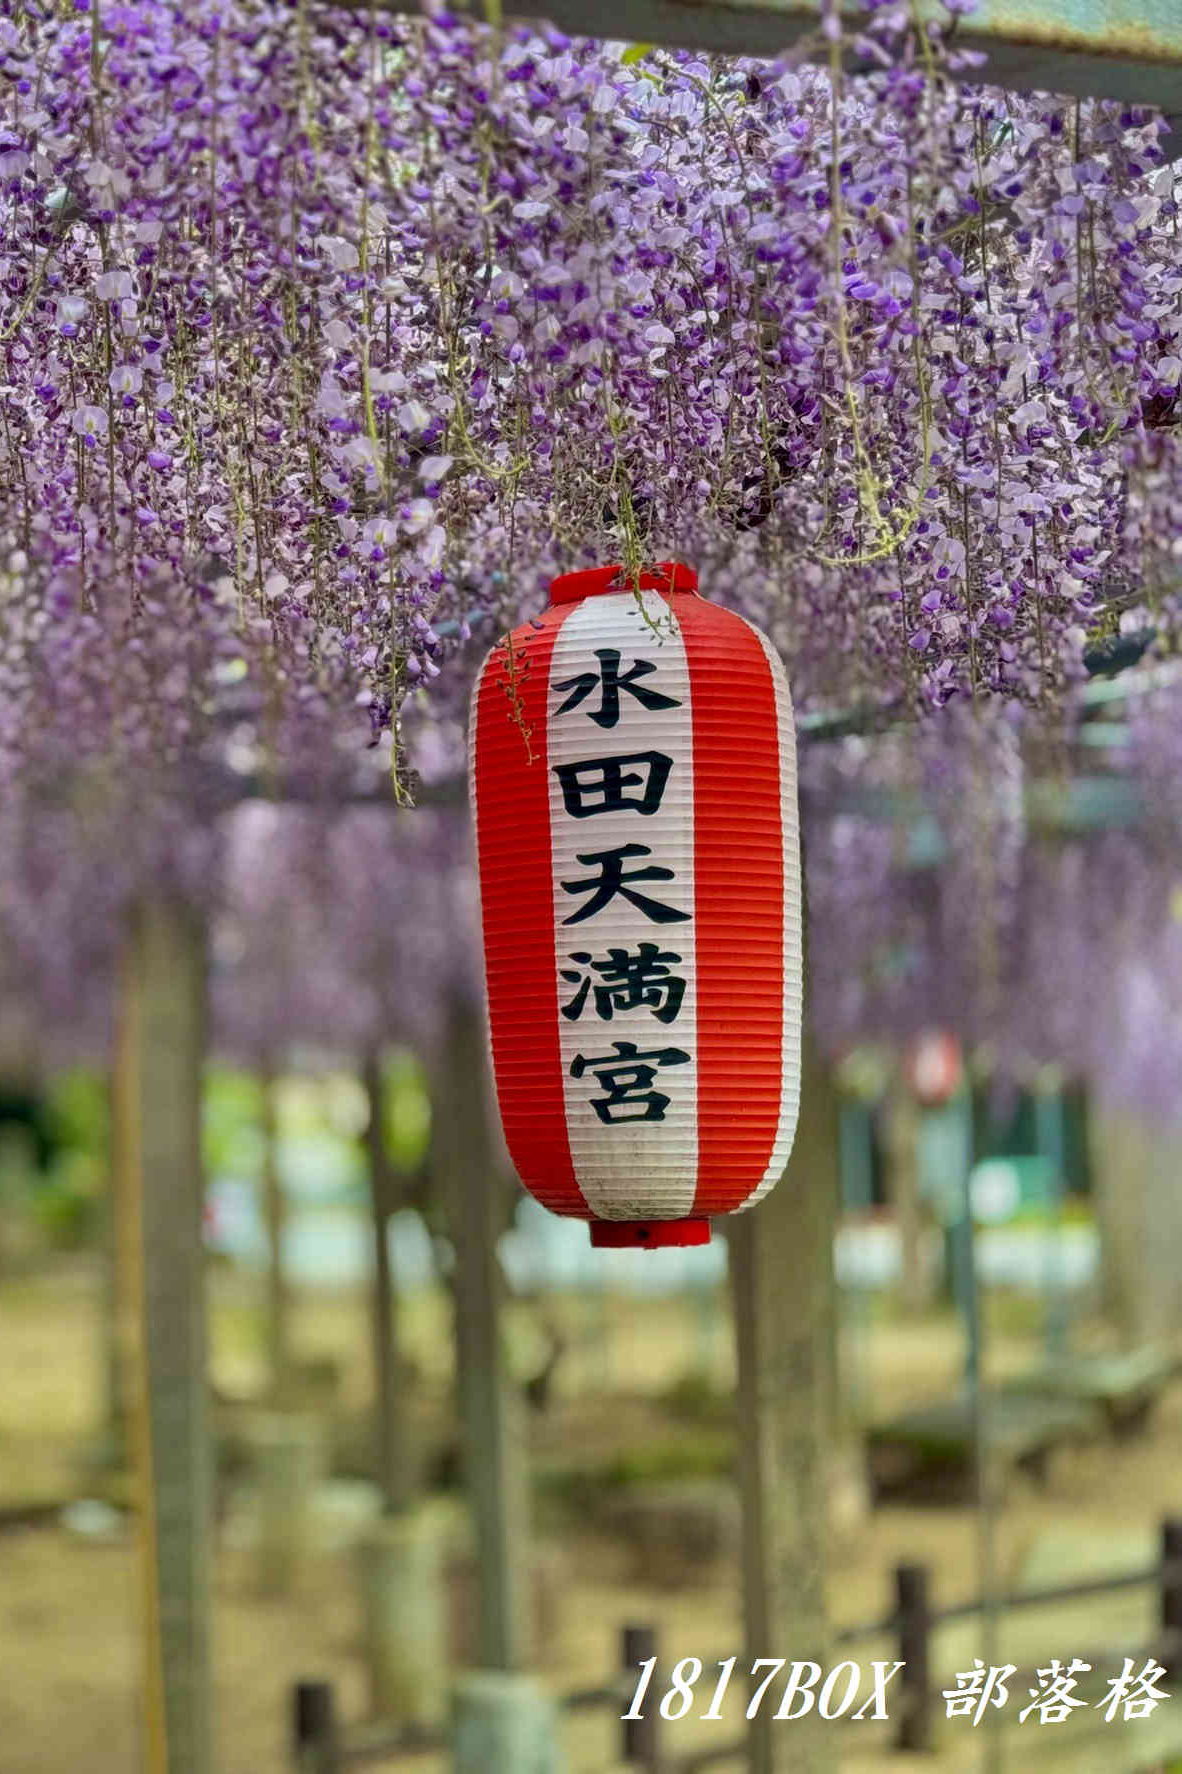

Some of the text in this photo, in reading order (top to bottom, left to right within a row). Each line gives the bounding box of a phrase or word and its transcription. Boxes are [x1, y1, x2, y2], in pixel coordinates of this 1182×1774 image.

[551, 648, 692, 1125] 水田天満宮
